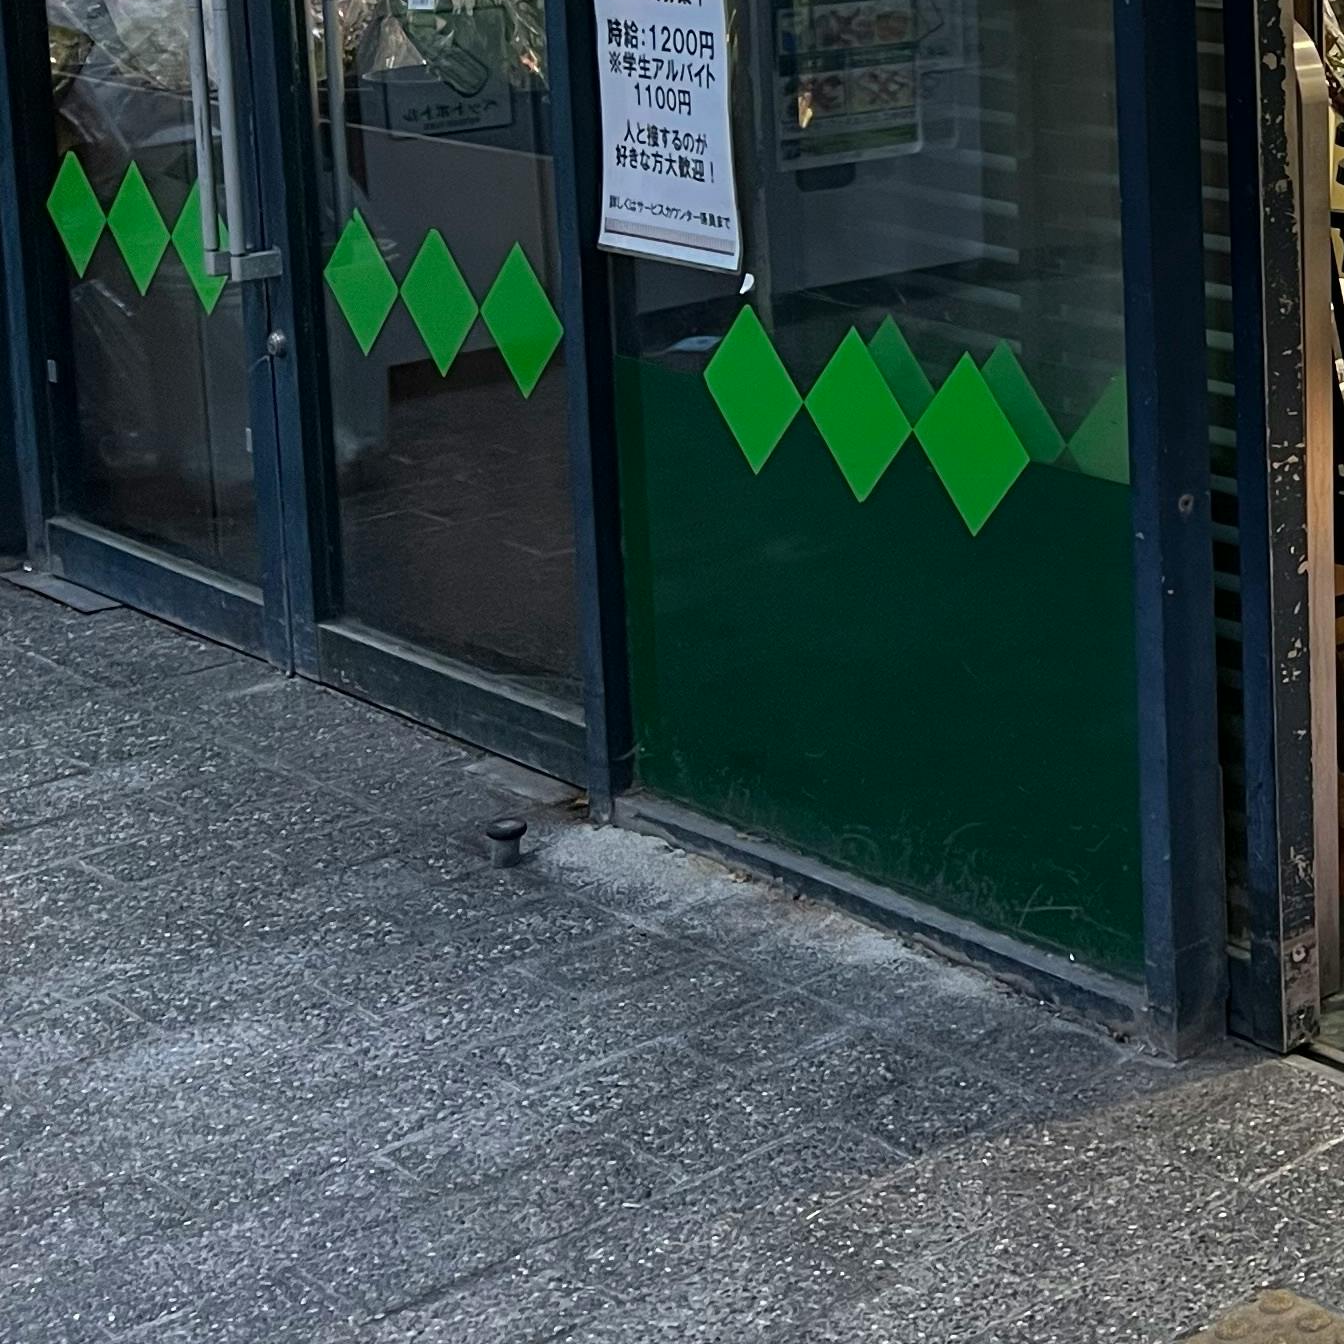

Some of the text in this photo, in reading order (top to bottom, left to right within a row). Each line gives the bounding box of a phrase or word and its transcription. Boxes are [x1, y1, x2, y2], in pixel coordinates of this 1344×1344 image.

[606, 18, 715, 61] 時給:1200円
[634, 82, 692, 116] 1100円
[622, 119, 709, 152] 人と接するのが
